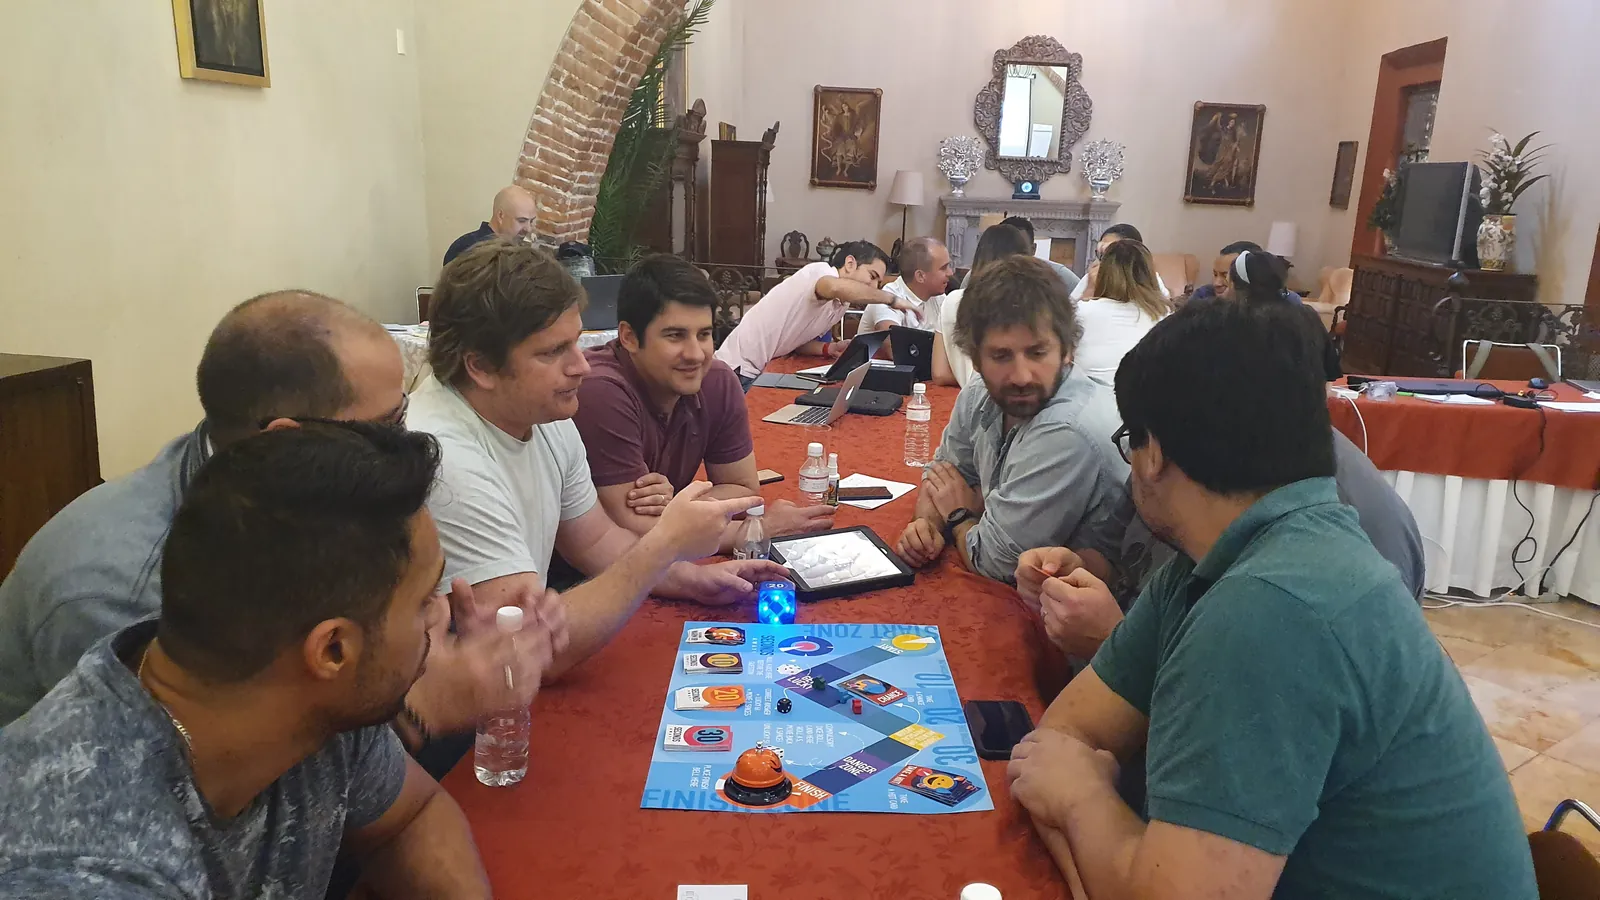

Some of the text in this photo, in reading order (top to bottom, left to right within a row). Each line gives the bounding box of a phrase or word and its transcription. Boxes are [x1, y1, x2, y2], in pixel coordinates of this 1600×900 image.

[803, 624, 939, 640] START ZONE
[759, 634, 775, 656] SECONDS
[711, 656, 734, 665] 10
[787, 676, 813, 690] LUCKY
[914, 673, 955, 688] 10
[692, 689, 701, 702] SECONDS
[714, 689, 740, 702] 20
[877, 690, 903, 704] CHANCE
[923, 707, 965, 725] 20
[672, 727, 683, 742] SECONDS
[696, 729, 724, 742] 30
[932, 745, 978, 765] 30
[838, 763, 865, 777] ZONE
[842, 756, 877, 775] DANGER
[689, 766, 701, 788] BELL HERE
[701, 765, 712, 790] PLACE FINISH
[793, 781, 828, 799] FINISH
[641, 790, 750, 811] FINIS
